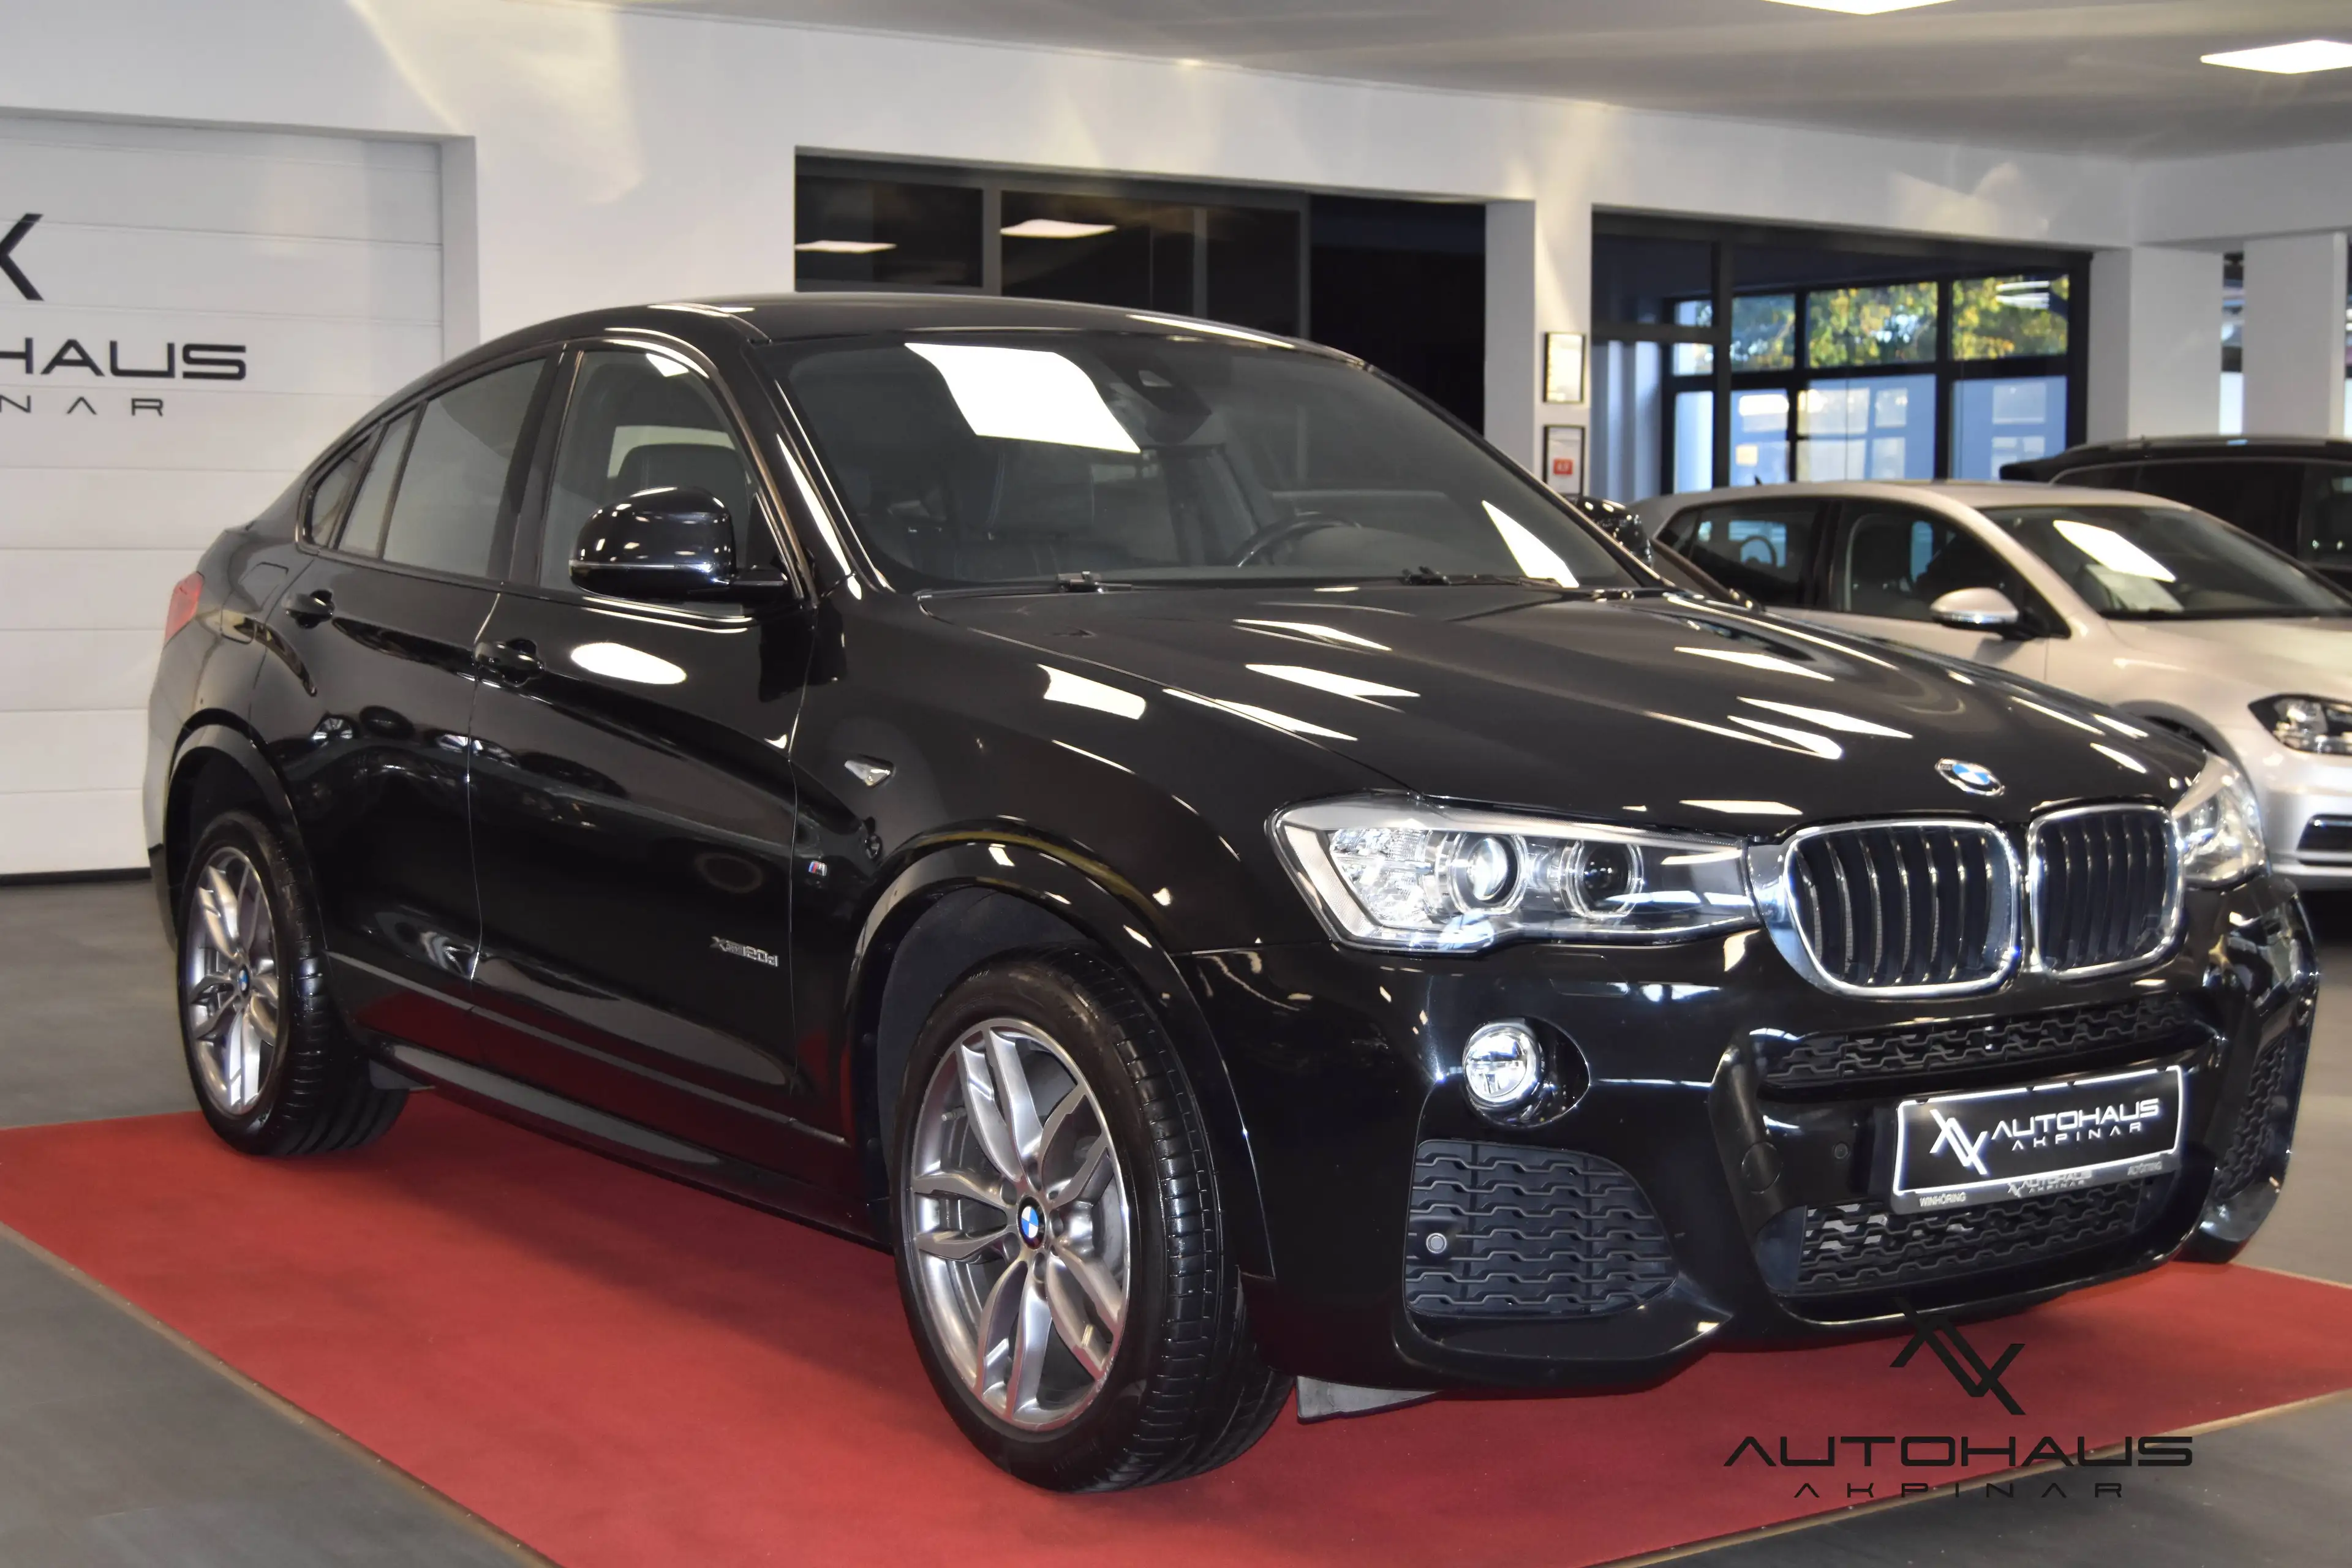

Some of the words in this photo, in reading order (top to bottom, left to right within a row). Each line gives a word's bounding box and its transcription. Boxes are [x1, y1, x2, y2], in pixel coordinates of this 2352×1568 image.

[1991, 1098, 2159, 1140] AUTOHAUS
[2011, 1121, 2142, 1151] AKPINAR
[1919, 1191, 1966, 1207] WINHÖRING
